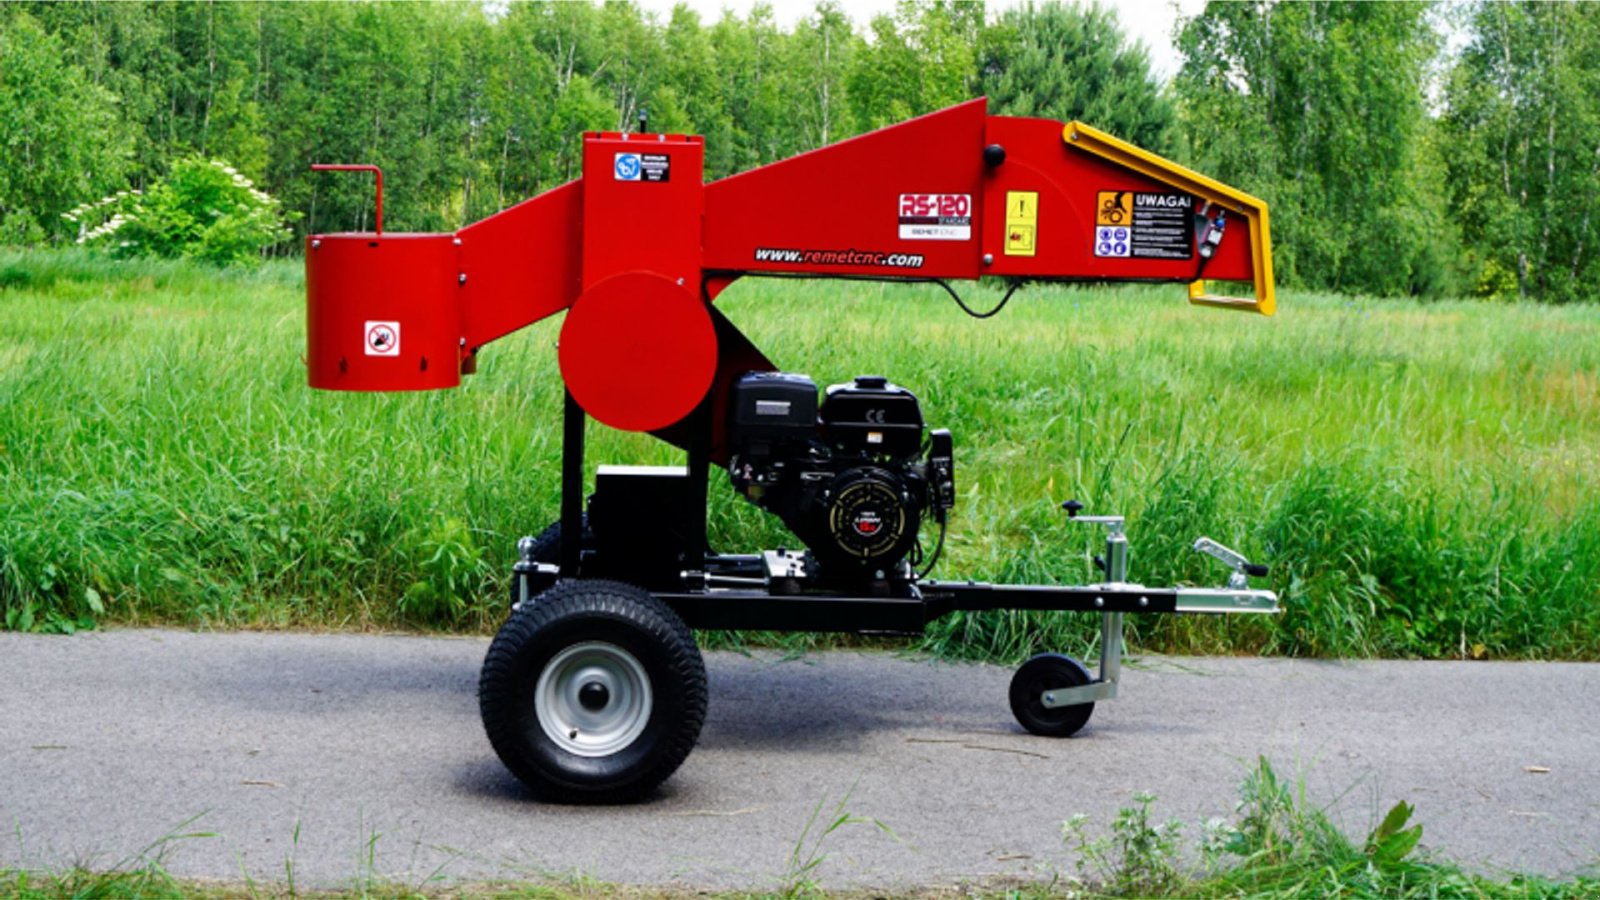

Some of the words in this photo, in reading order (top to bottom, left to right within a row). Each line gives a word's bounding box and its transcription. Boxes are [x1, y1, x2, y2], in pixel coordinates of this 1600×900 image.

[902, 195, 969, 217] RS-120
[1135, 194, 1191, 207] UWAGA!
[755, 248, 924, 267] www.remetcnc.com
